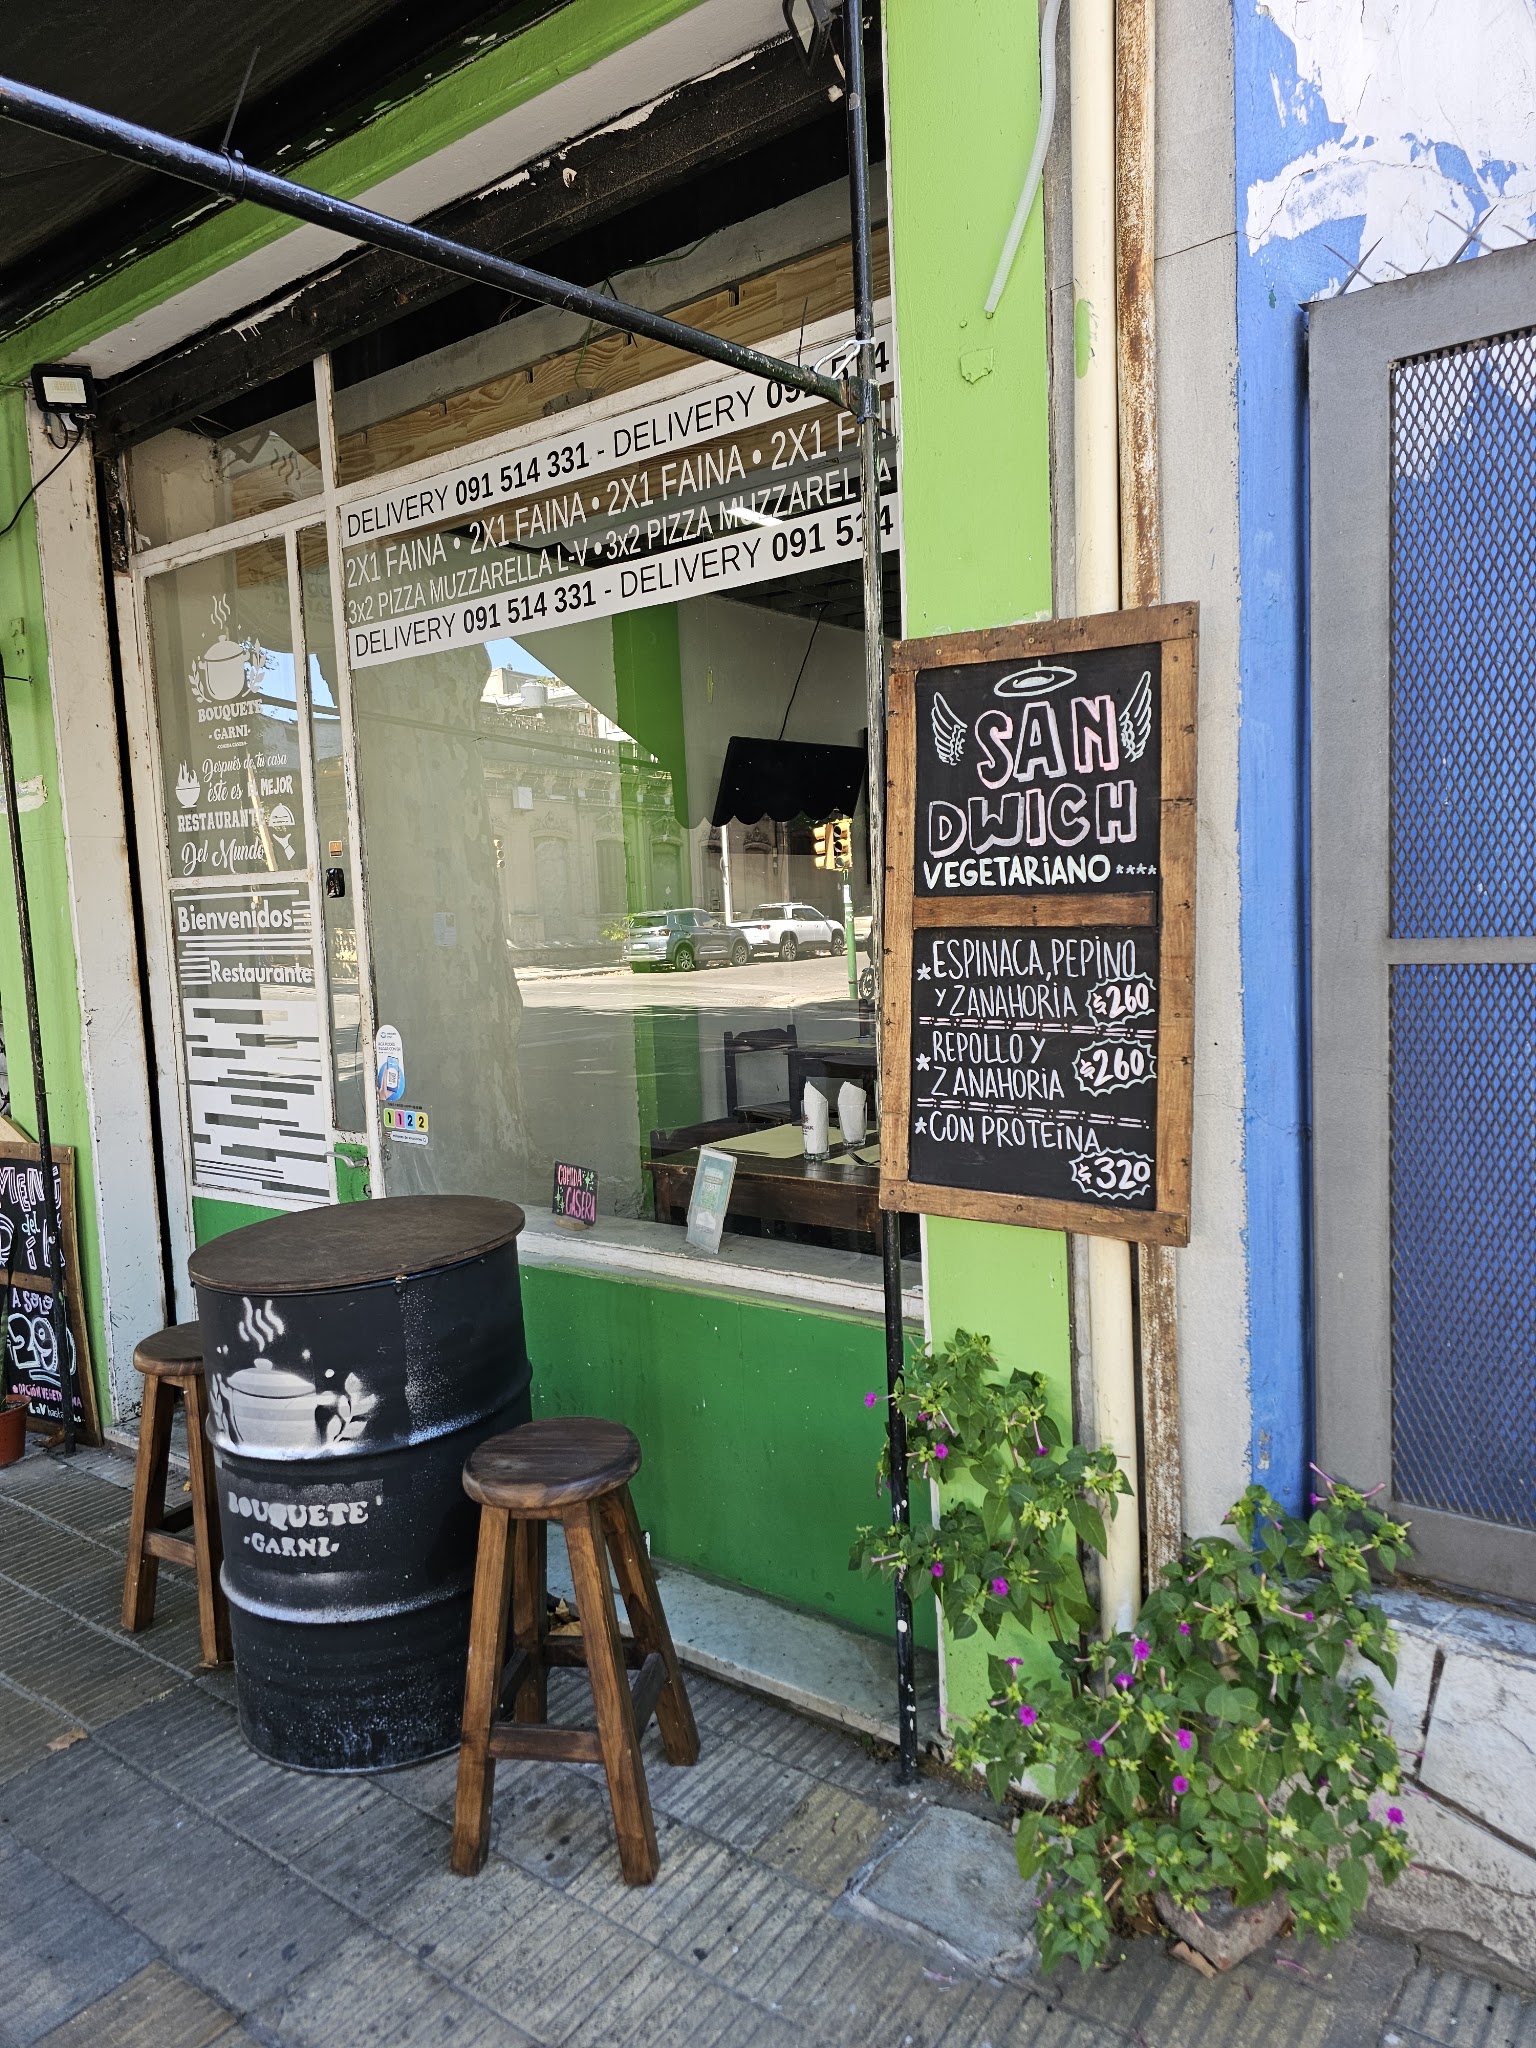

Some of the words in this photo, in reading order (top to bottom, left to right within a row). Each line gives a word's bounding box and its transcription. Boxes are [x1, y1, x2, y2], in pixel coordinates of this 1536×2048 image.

[347, 485, 449, 538] DELIVERY
[455, 476, 494, 506] 091
[500, 457, 540, 492] 514
[547, 442, 590, 478] 331
[614, 385, 755, 458] DELIVERY
[347, 552, 380, 588] 2X1
[387, 533, 447, 577] FAINA
[469, 515, 510, 555] 2X1
[516, 492, 587, 542] FAINA
[606, 471, 654, 517] 2X1
[661, 445, 746, 500] FAINA
[771, 419, 827, 471] 2X1
[348, 595, 374, 625] 3x2
[378, 586, 425, 618] PIZZA
[429, 549, 552, 604] MUZZARELLA
[557, 538, 589, 572] L-V
[606, 523, 642, 560] 3x2
[648, 505, 714, 550] PIZZA
[719, 457, 892, 531] MUZZARELA
[355, 613, 456, 657] DELIVERY
[463, 603, 501, 635] 091
[507, 592, 548, 624] 514
[554, 580, 597, 613] 331
[620, 537, 762, 598] DELIVERY
[772, 522, 826, 562] 091
[198, 699, 263, 723] BOUQUETE
[974, 695, 1120, 789] SAN
[202, 756, 242, 783] Después
[243, 754, 256, 769] de
[255, 752, 265, 768] tu
[267, 754, 287, 767] casa
[230, 783, 243, 800] es
[260, 775, 294, 797] MEJOR
[177, 808, 265, 832] RESTAURANTE
[928, 780, 1138, 858] DWICH
[181, 840, 209, 876] Del
[212, 836, 265, 874] Mundo
[177, 899, 293, 933] Bienvenidos
[211, 959, 312, 984] Restaurante
[1092, 981, 1150, 1019] $260
[932, 1030, 1023, 1065] REPOLLO
[1080, 1047, 1145, 1087] $260
[929, 1111, 975, 1143] CON
[558, 1164, 582, 1187] COMIDA
[1077, 1156, 1151, 1190] $320
[21, 1210, 40, 1235] del
[565, 1187, 596, 1223] CASERA
[12, 1287, 21, 1308] A
[23, 1290, 53, 1315] SOLO
[227, 1491, 369, 1530] BOUQUETE
